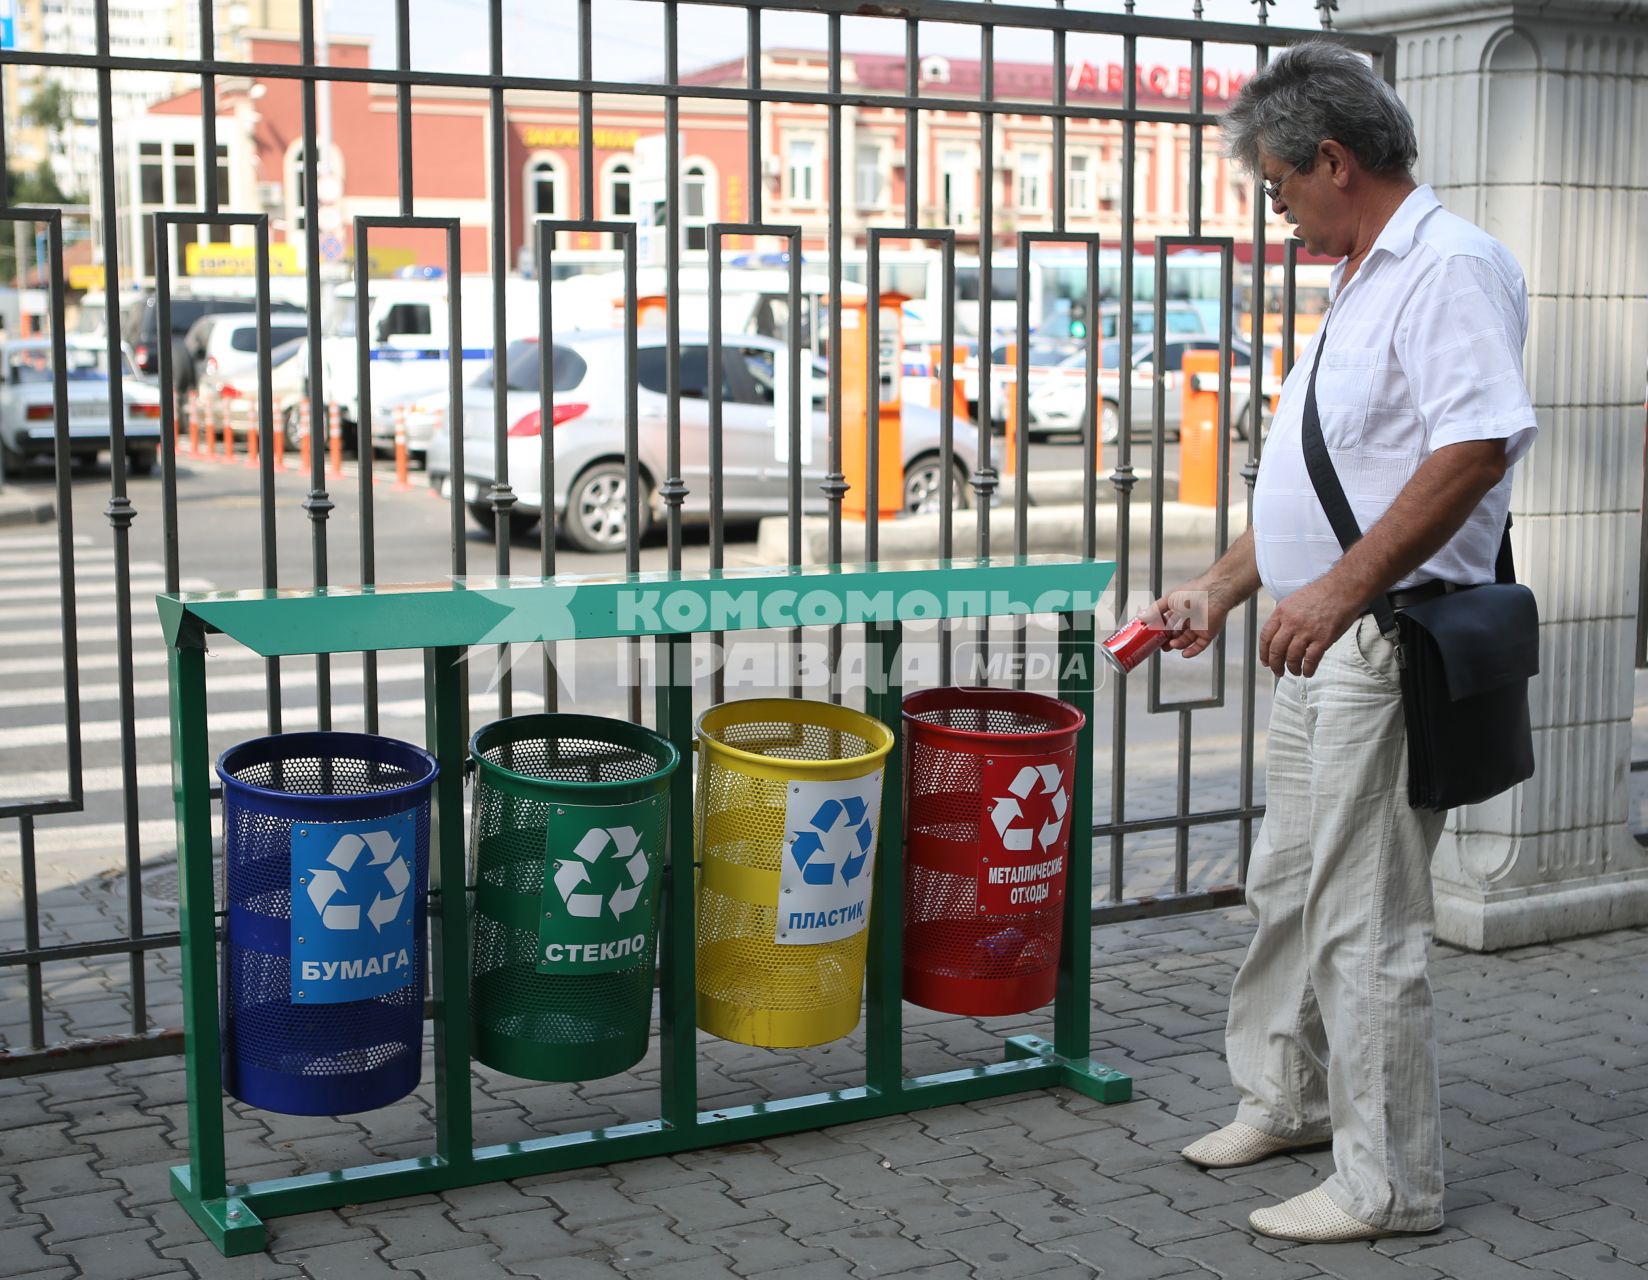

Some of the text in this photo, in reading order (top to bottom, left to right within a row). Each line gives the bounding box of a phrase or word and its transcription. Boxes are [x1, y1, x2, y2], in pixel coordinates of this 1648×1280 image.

[988, 856, 1063, 884] МЕТАЛЛИЧЕСКИЕ
[1010, 882, 1049, 905] ОТХОДЫ
[788, 900, 864, 929] ПЛАСТИК
[545, 934, 645, 962] СТЕКЛО
[302, 948, 409, 980] БУМАГА
